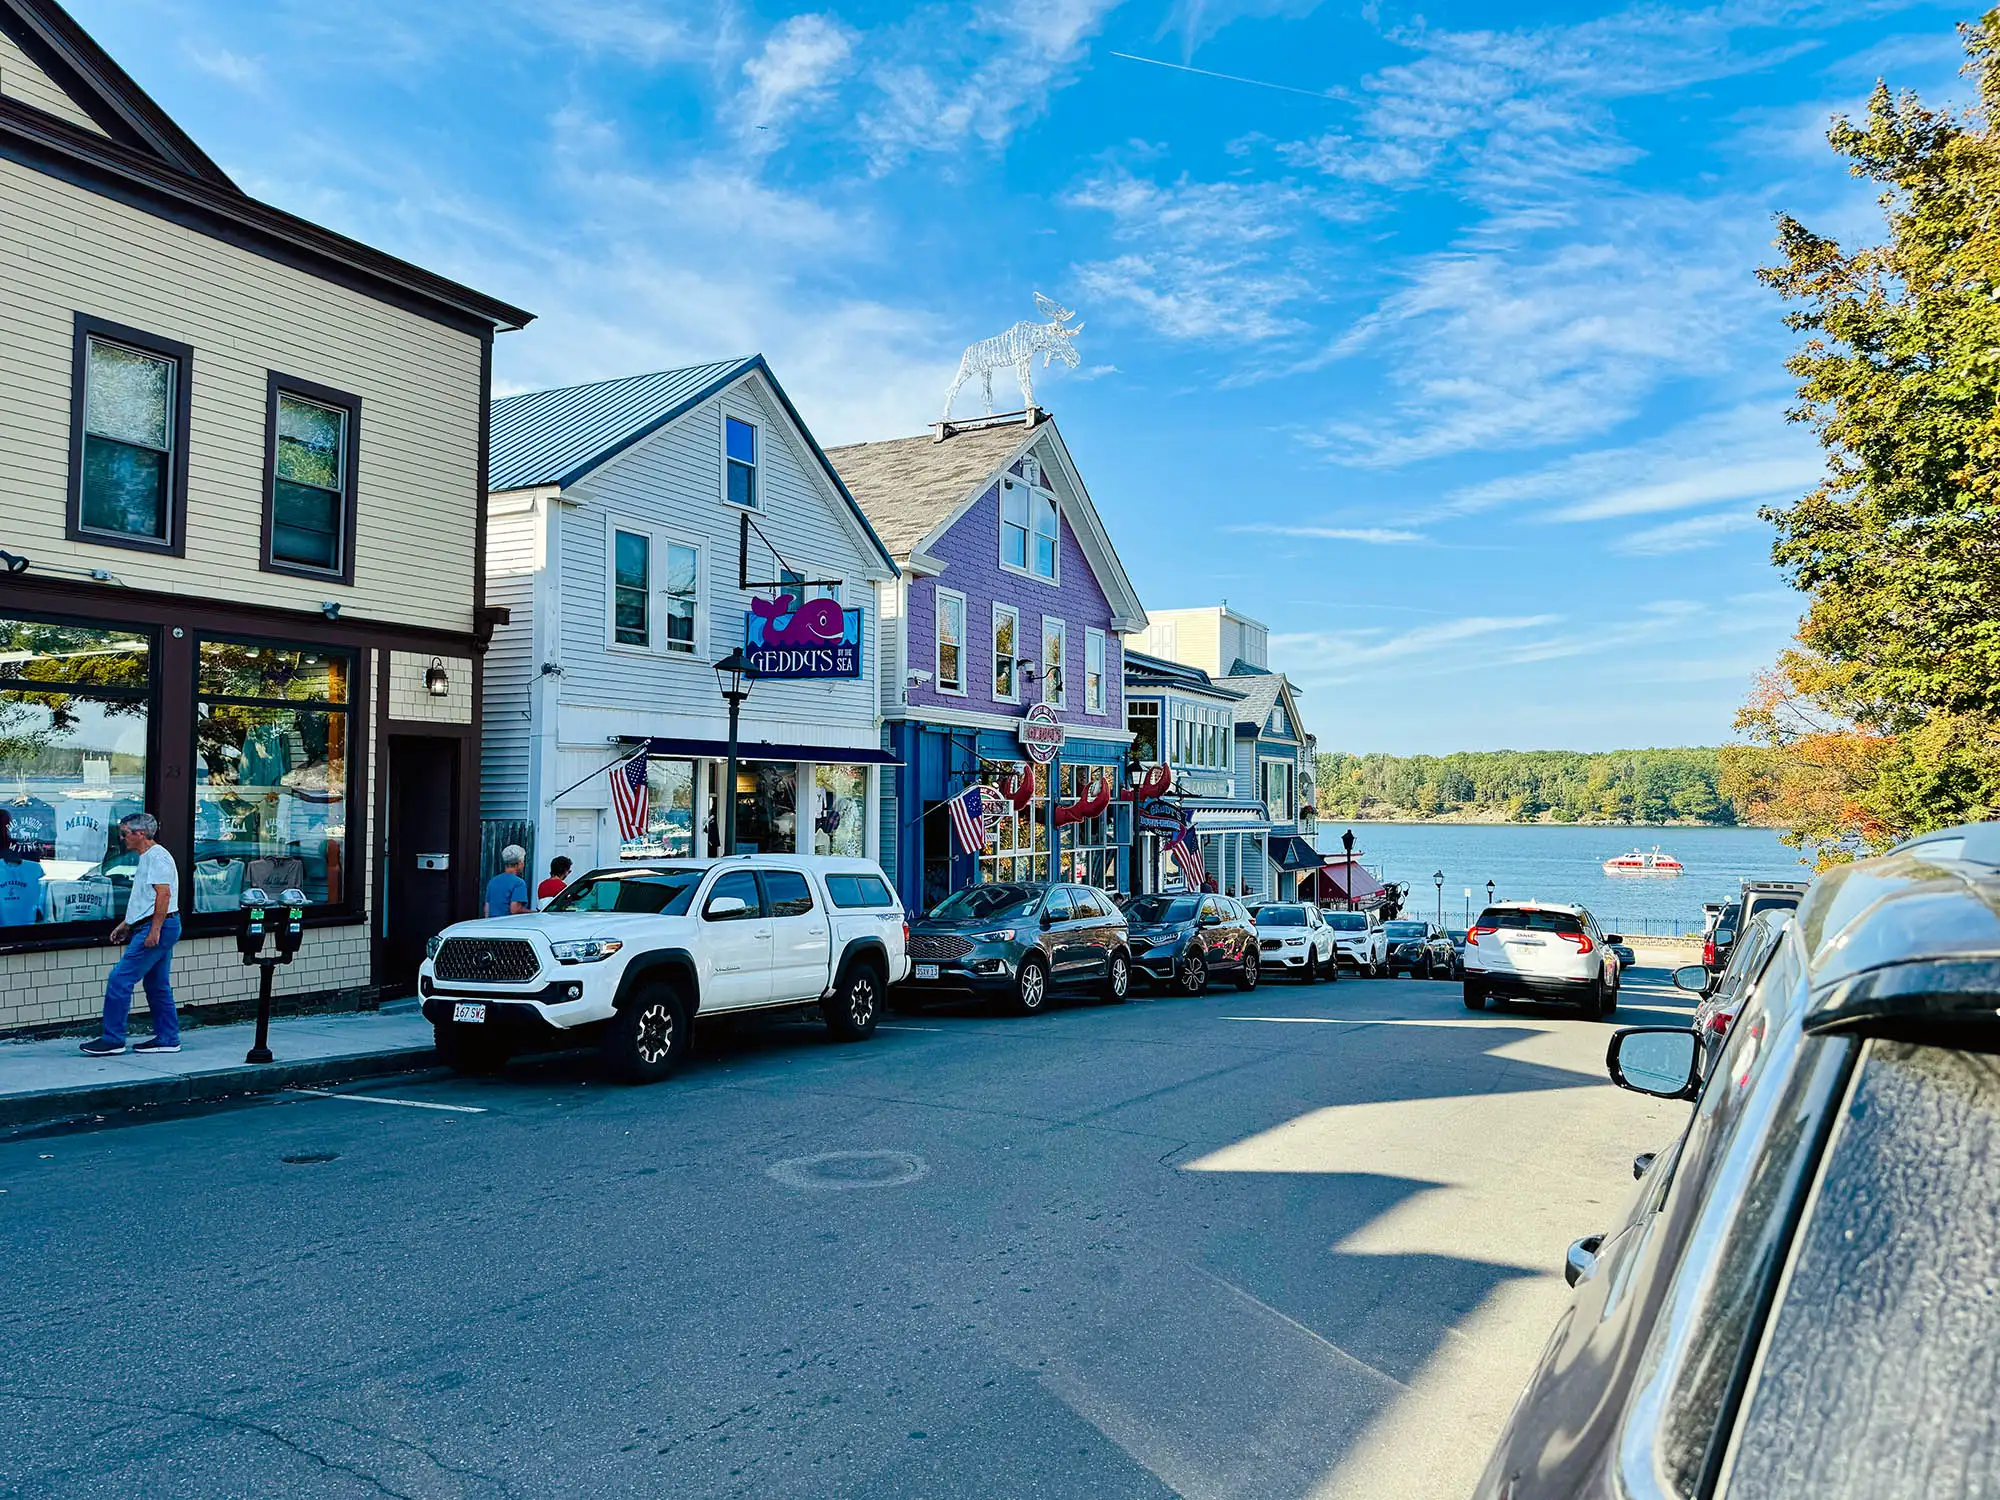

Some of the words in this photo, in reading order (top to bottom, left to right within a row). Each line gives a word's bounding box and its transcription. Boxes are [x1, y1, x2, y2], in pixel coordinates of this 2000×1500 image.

[750, 649, 833, 672] GEDDY'S
[837, 658, 853, 671] SEA
[65, 815, 100, 832] MAINE
[568, 835, 575, 843] 21
[455, 1006, 470, 1018] 167
